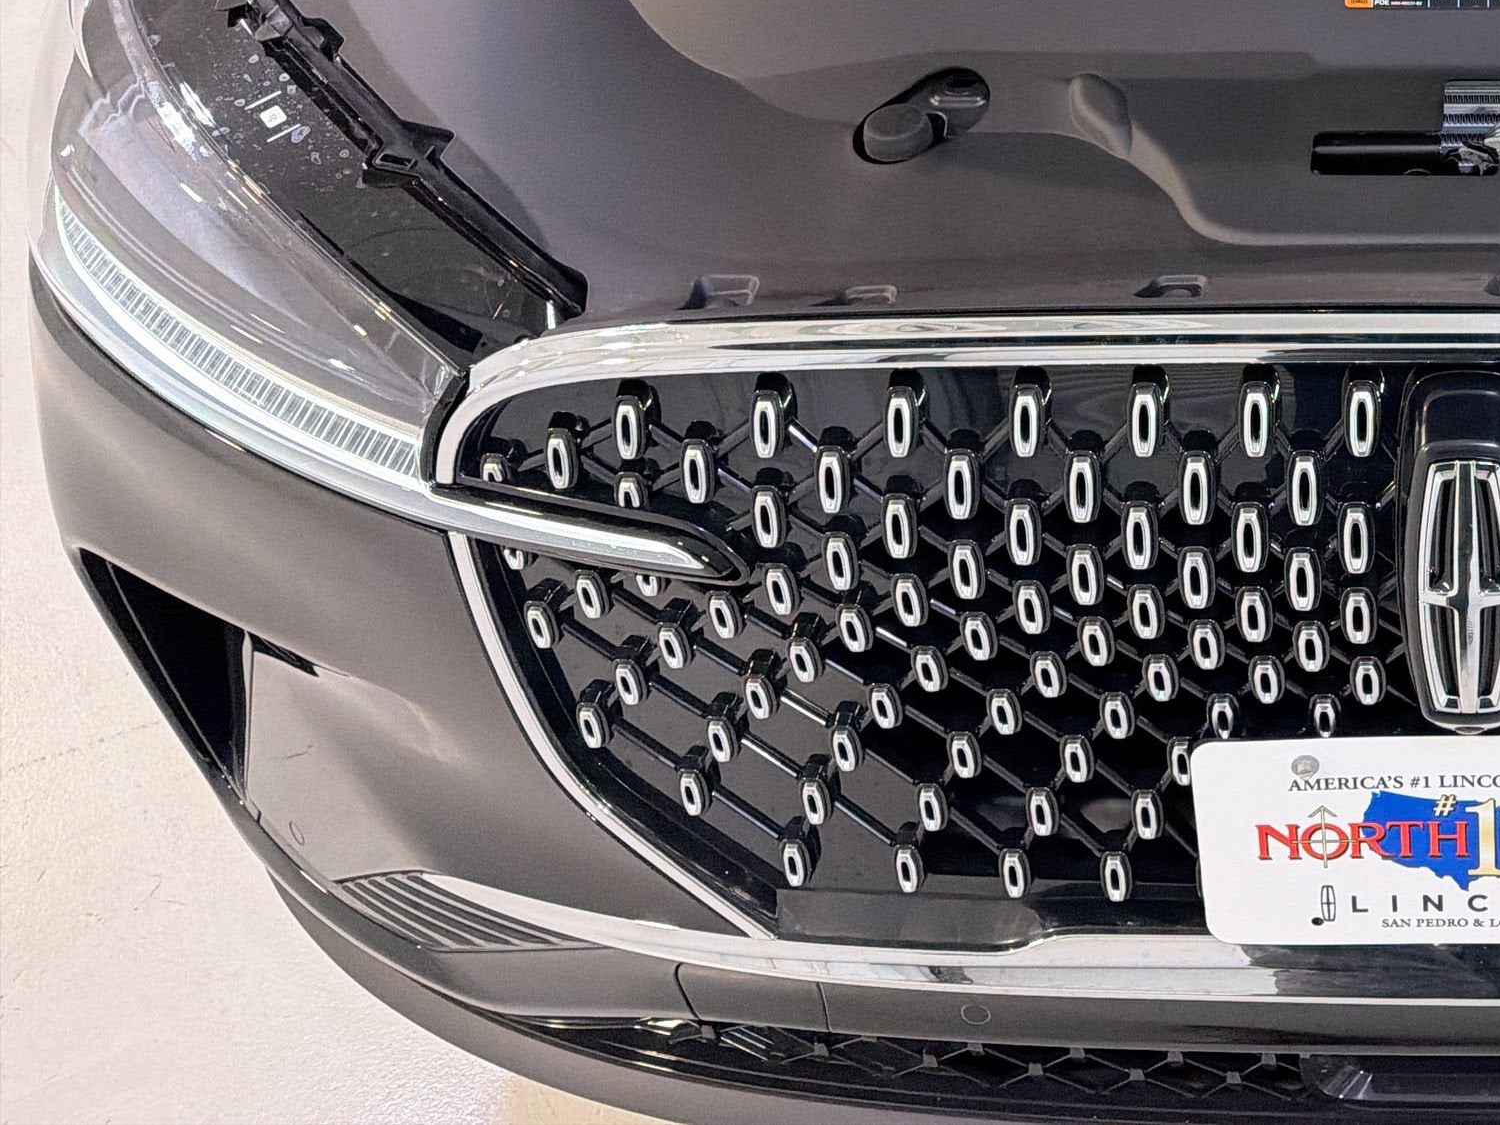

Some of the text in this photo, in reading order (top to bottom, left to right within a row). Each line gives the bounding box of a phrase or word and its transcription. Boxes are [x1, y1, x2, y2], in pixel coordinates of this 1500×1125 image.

[1288, 776, 1404, 792] AMERICA'S
[1410, 776, 1432, 788] #1
[1255, 820, 1469, 860] NORTH
[1382, 918, 1412, 928] SAN
[1416, 918, 1469, 928] PEDRO
[1472, 918, 1486, 928] &
